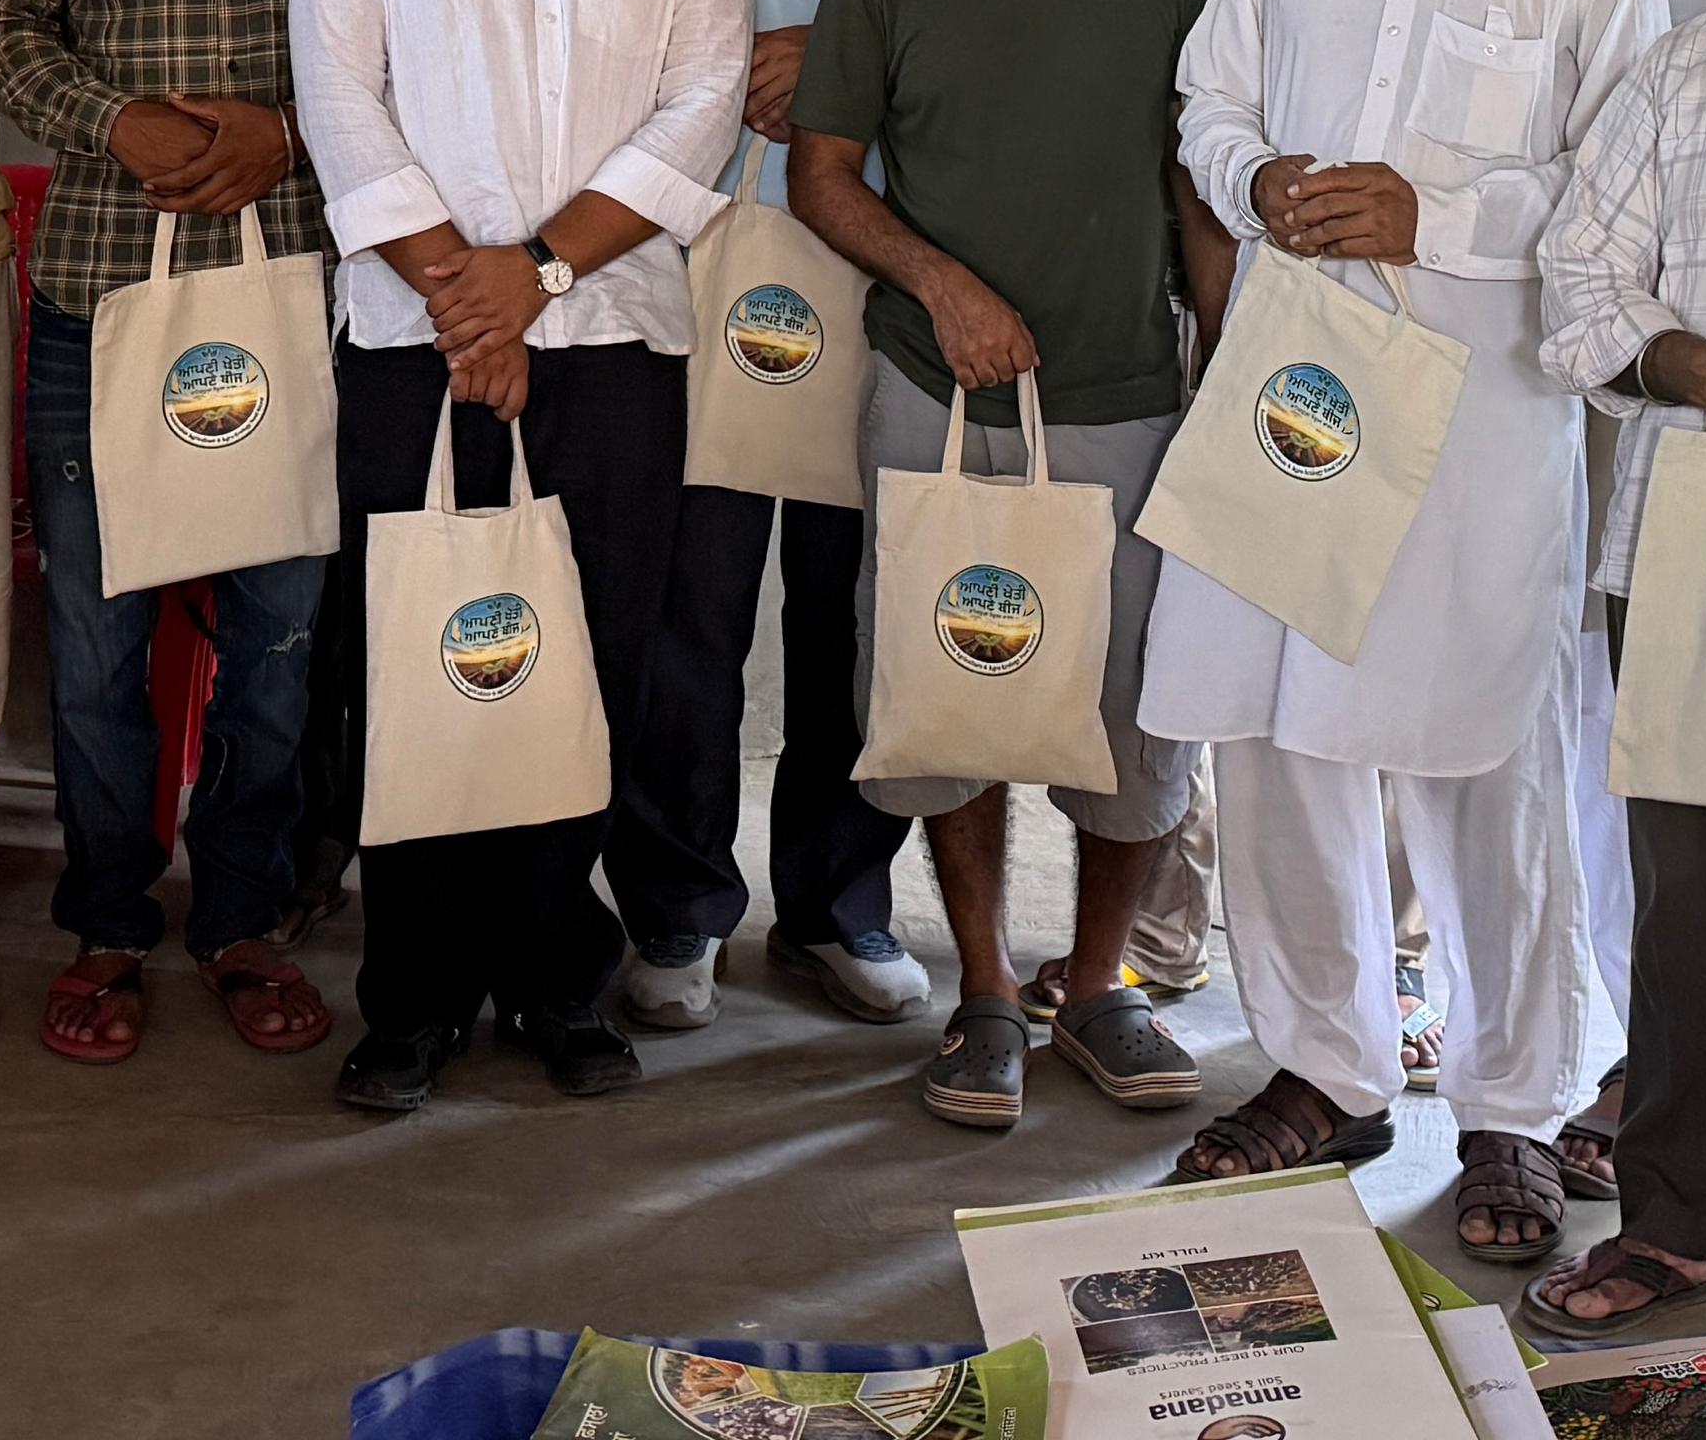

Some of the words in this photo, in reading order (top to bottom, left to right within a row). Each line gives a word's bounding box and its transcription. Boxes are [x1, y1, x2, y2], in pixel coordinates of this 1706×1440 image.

[960, 582, 998, 598] ਆਪਣੀ
[1003, 584, 1026, 600] ਖੇਤੀ
[962, 596, 995, 611] ਆਪਣੇ
[998, 600, 1021, 614] ਬੀਜ
[1140, 1251, 1165, 1261] KIT
[1166, 1246, 1208, 1257] FULL
[1252, 1349, 1268, 1358] 10
[1273, 1345, 1305, 1355] OUR
[1213, 1351, 1249, 1363] BEST
[1126, 1357, 1208, 1376] PRACTICES
[1208, 1381, 1240, 1393] Seed
[1244, 1379, 1253, 1388] &
[1257, 1376, 1284, 1386] Soil
[1159, 1386, 1204, 1400] Savers
[1149, 1385, 1302, 1421] annadana
